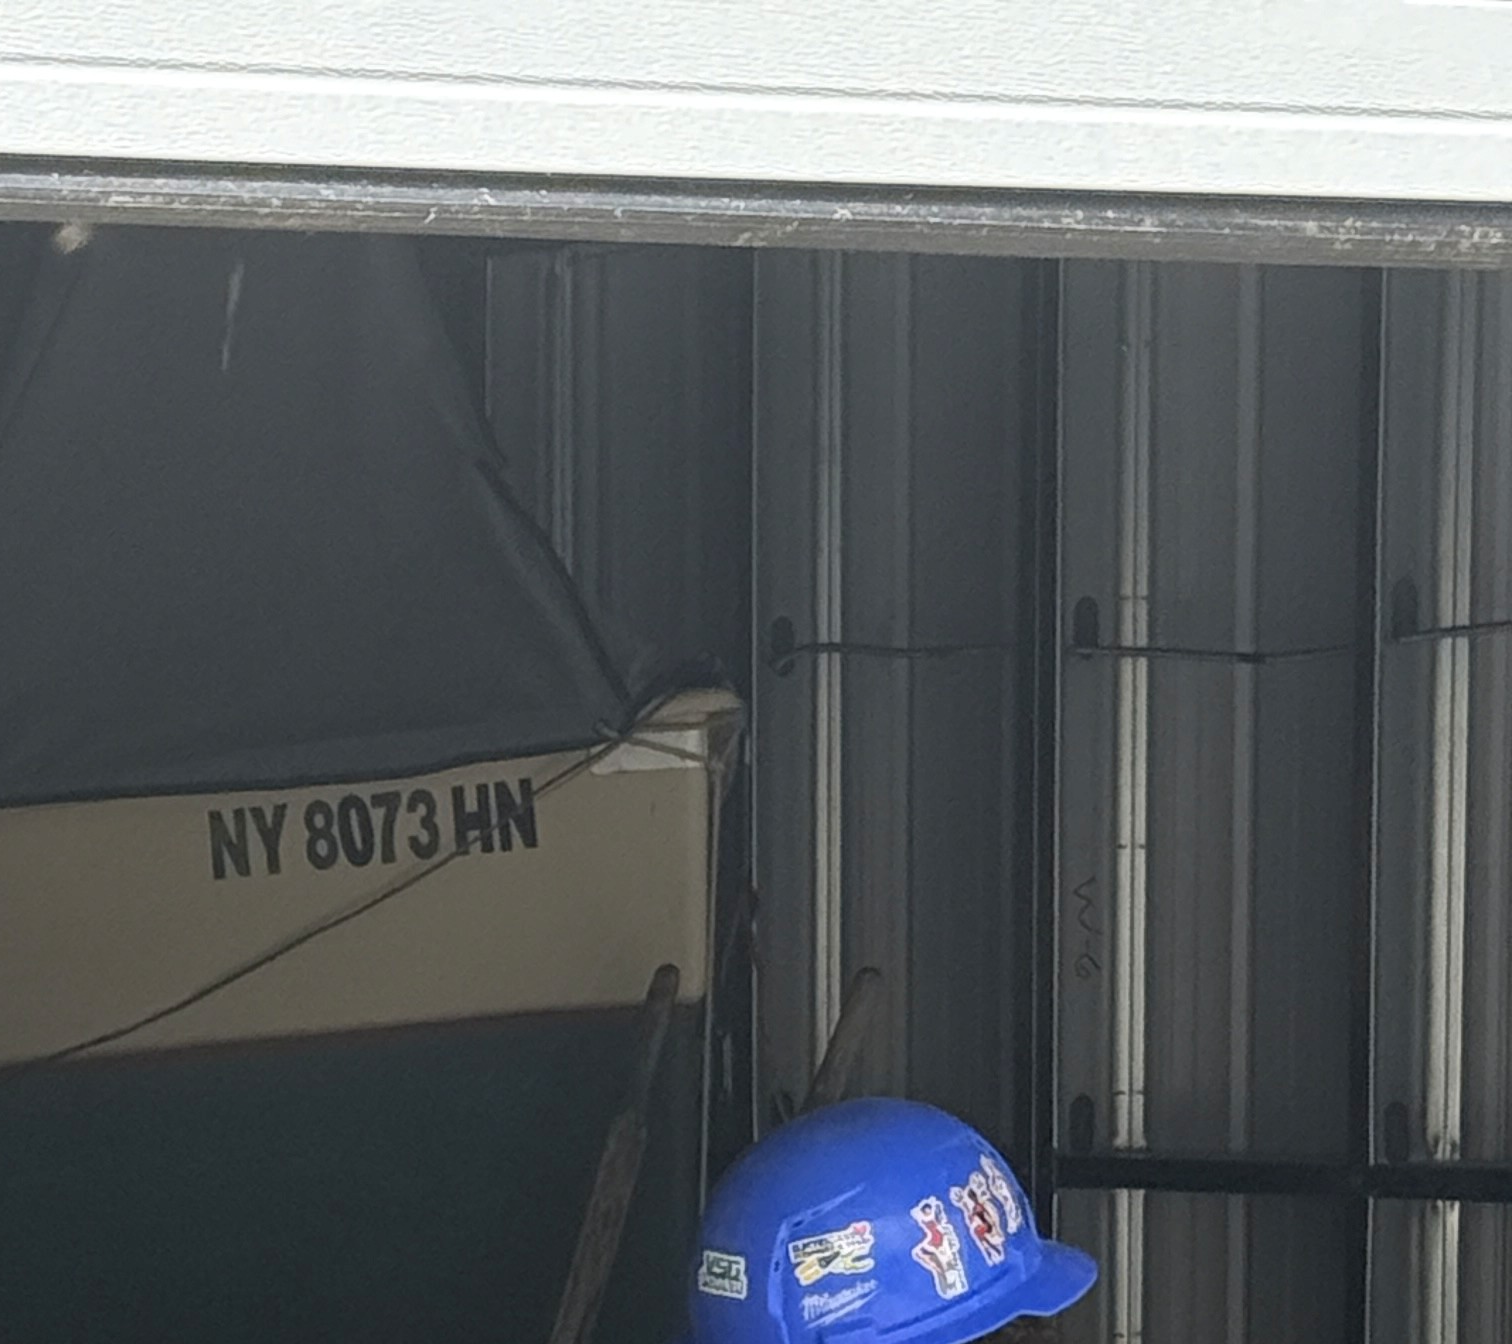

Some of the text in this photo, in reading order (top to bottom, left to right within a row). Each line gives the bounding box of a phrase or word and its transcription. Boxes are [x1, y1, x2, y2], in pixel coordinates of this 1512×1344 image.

[208, 778, 539, 880] NY 8073 HN
